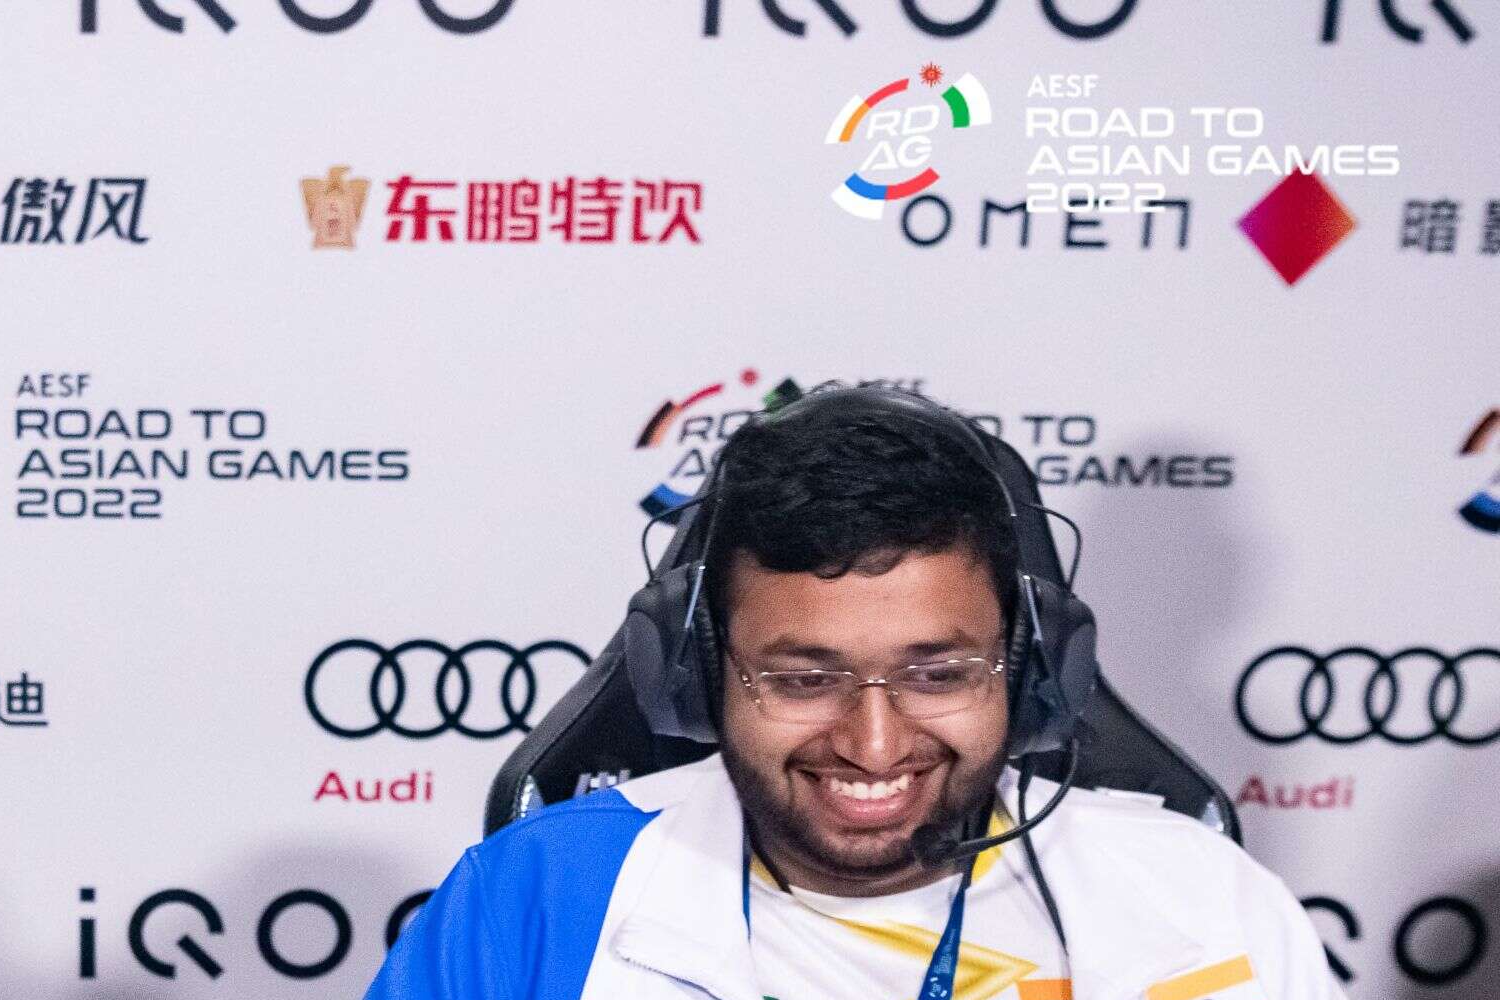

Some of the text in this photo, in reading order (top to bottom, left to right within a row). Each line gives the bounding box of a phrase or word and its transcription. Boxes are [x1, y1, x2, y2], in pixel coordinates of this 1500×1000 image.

[386, 175, 703, 244] 东鹏特饮
[17, 373, 90, 398] AESF
[16, 408, 267, 440] ROAD TO
[1021, 415, 1096, 447] TO
[17, 448, 410, 481] ASIAN GAMES
[1034, 455, 1235, 488] GAMES
[16, 487, 162, 519] 2022
[313, 771, 434, 803] Audi
[1236, 774, 1354, 809] Audi
